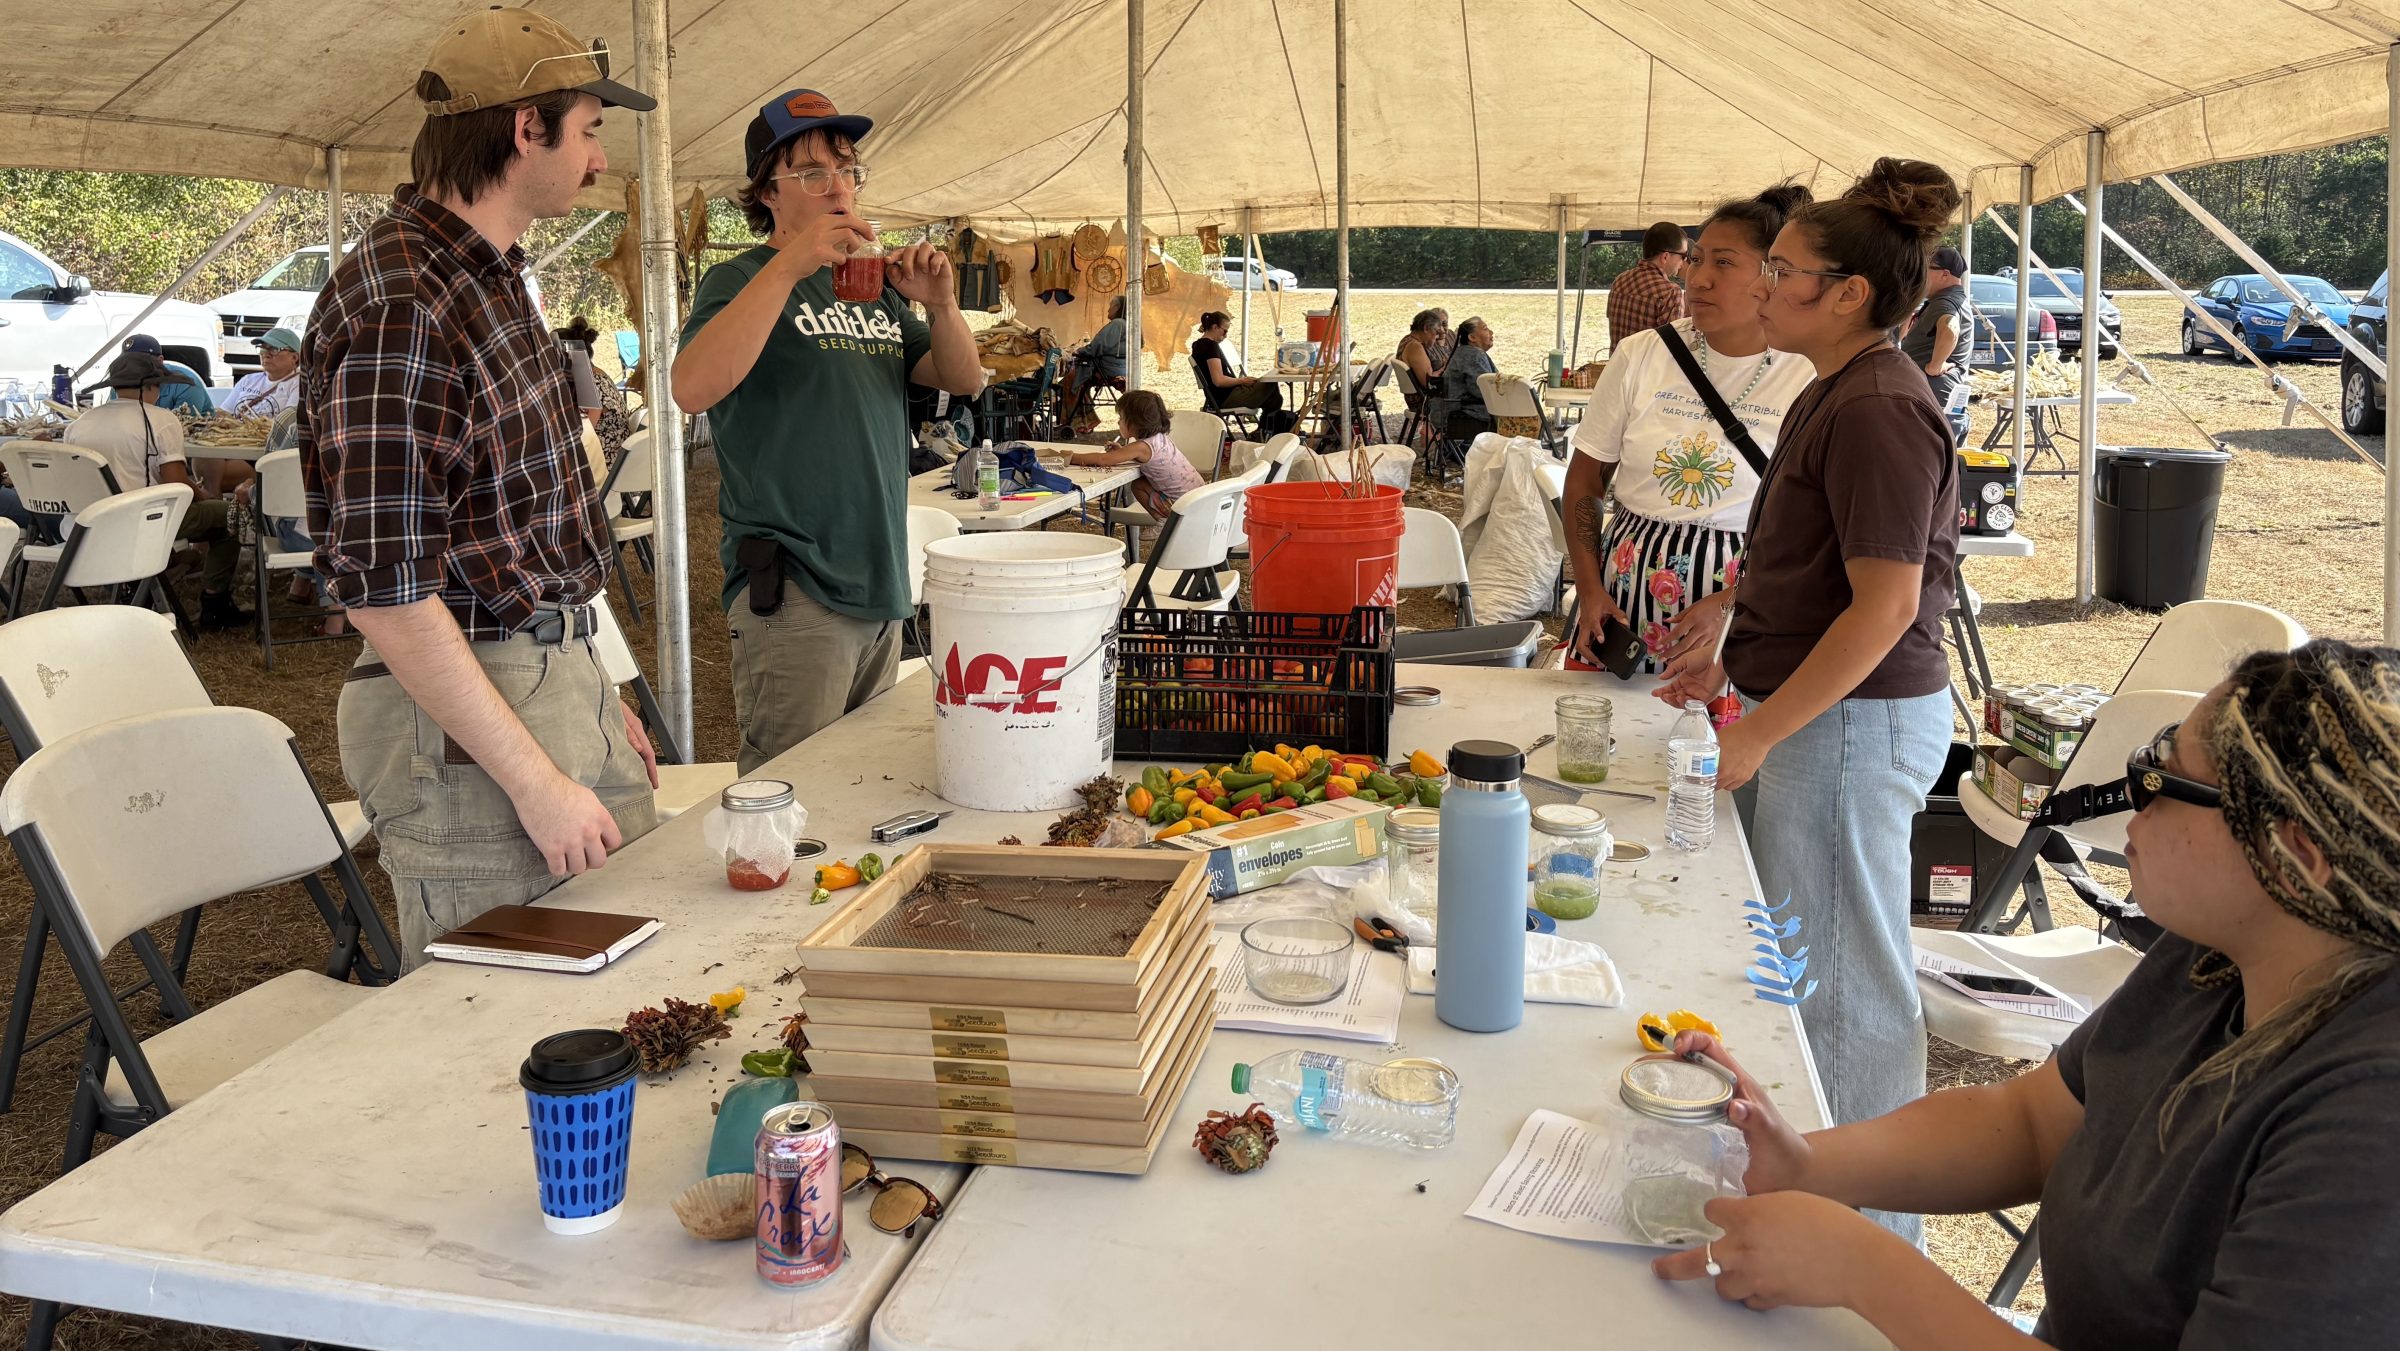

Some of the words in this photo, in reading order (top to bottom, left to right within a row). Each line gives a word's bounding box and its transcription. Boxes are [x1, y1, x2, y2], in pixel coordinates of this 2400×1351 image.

[819, 338, 856, 350] SEED
[859, 344, 904, 359] SUPPLY
[1654, 391, 1685, 403] GREAT
[936, 641, 1068, 714] ACE
[1236, 844, 1249, 858] #1
[1270, 840, 1285, 849] Coin
[1238, 847, 1303, 873] envelopes
[780, 1166, 821, 1216] La
